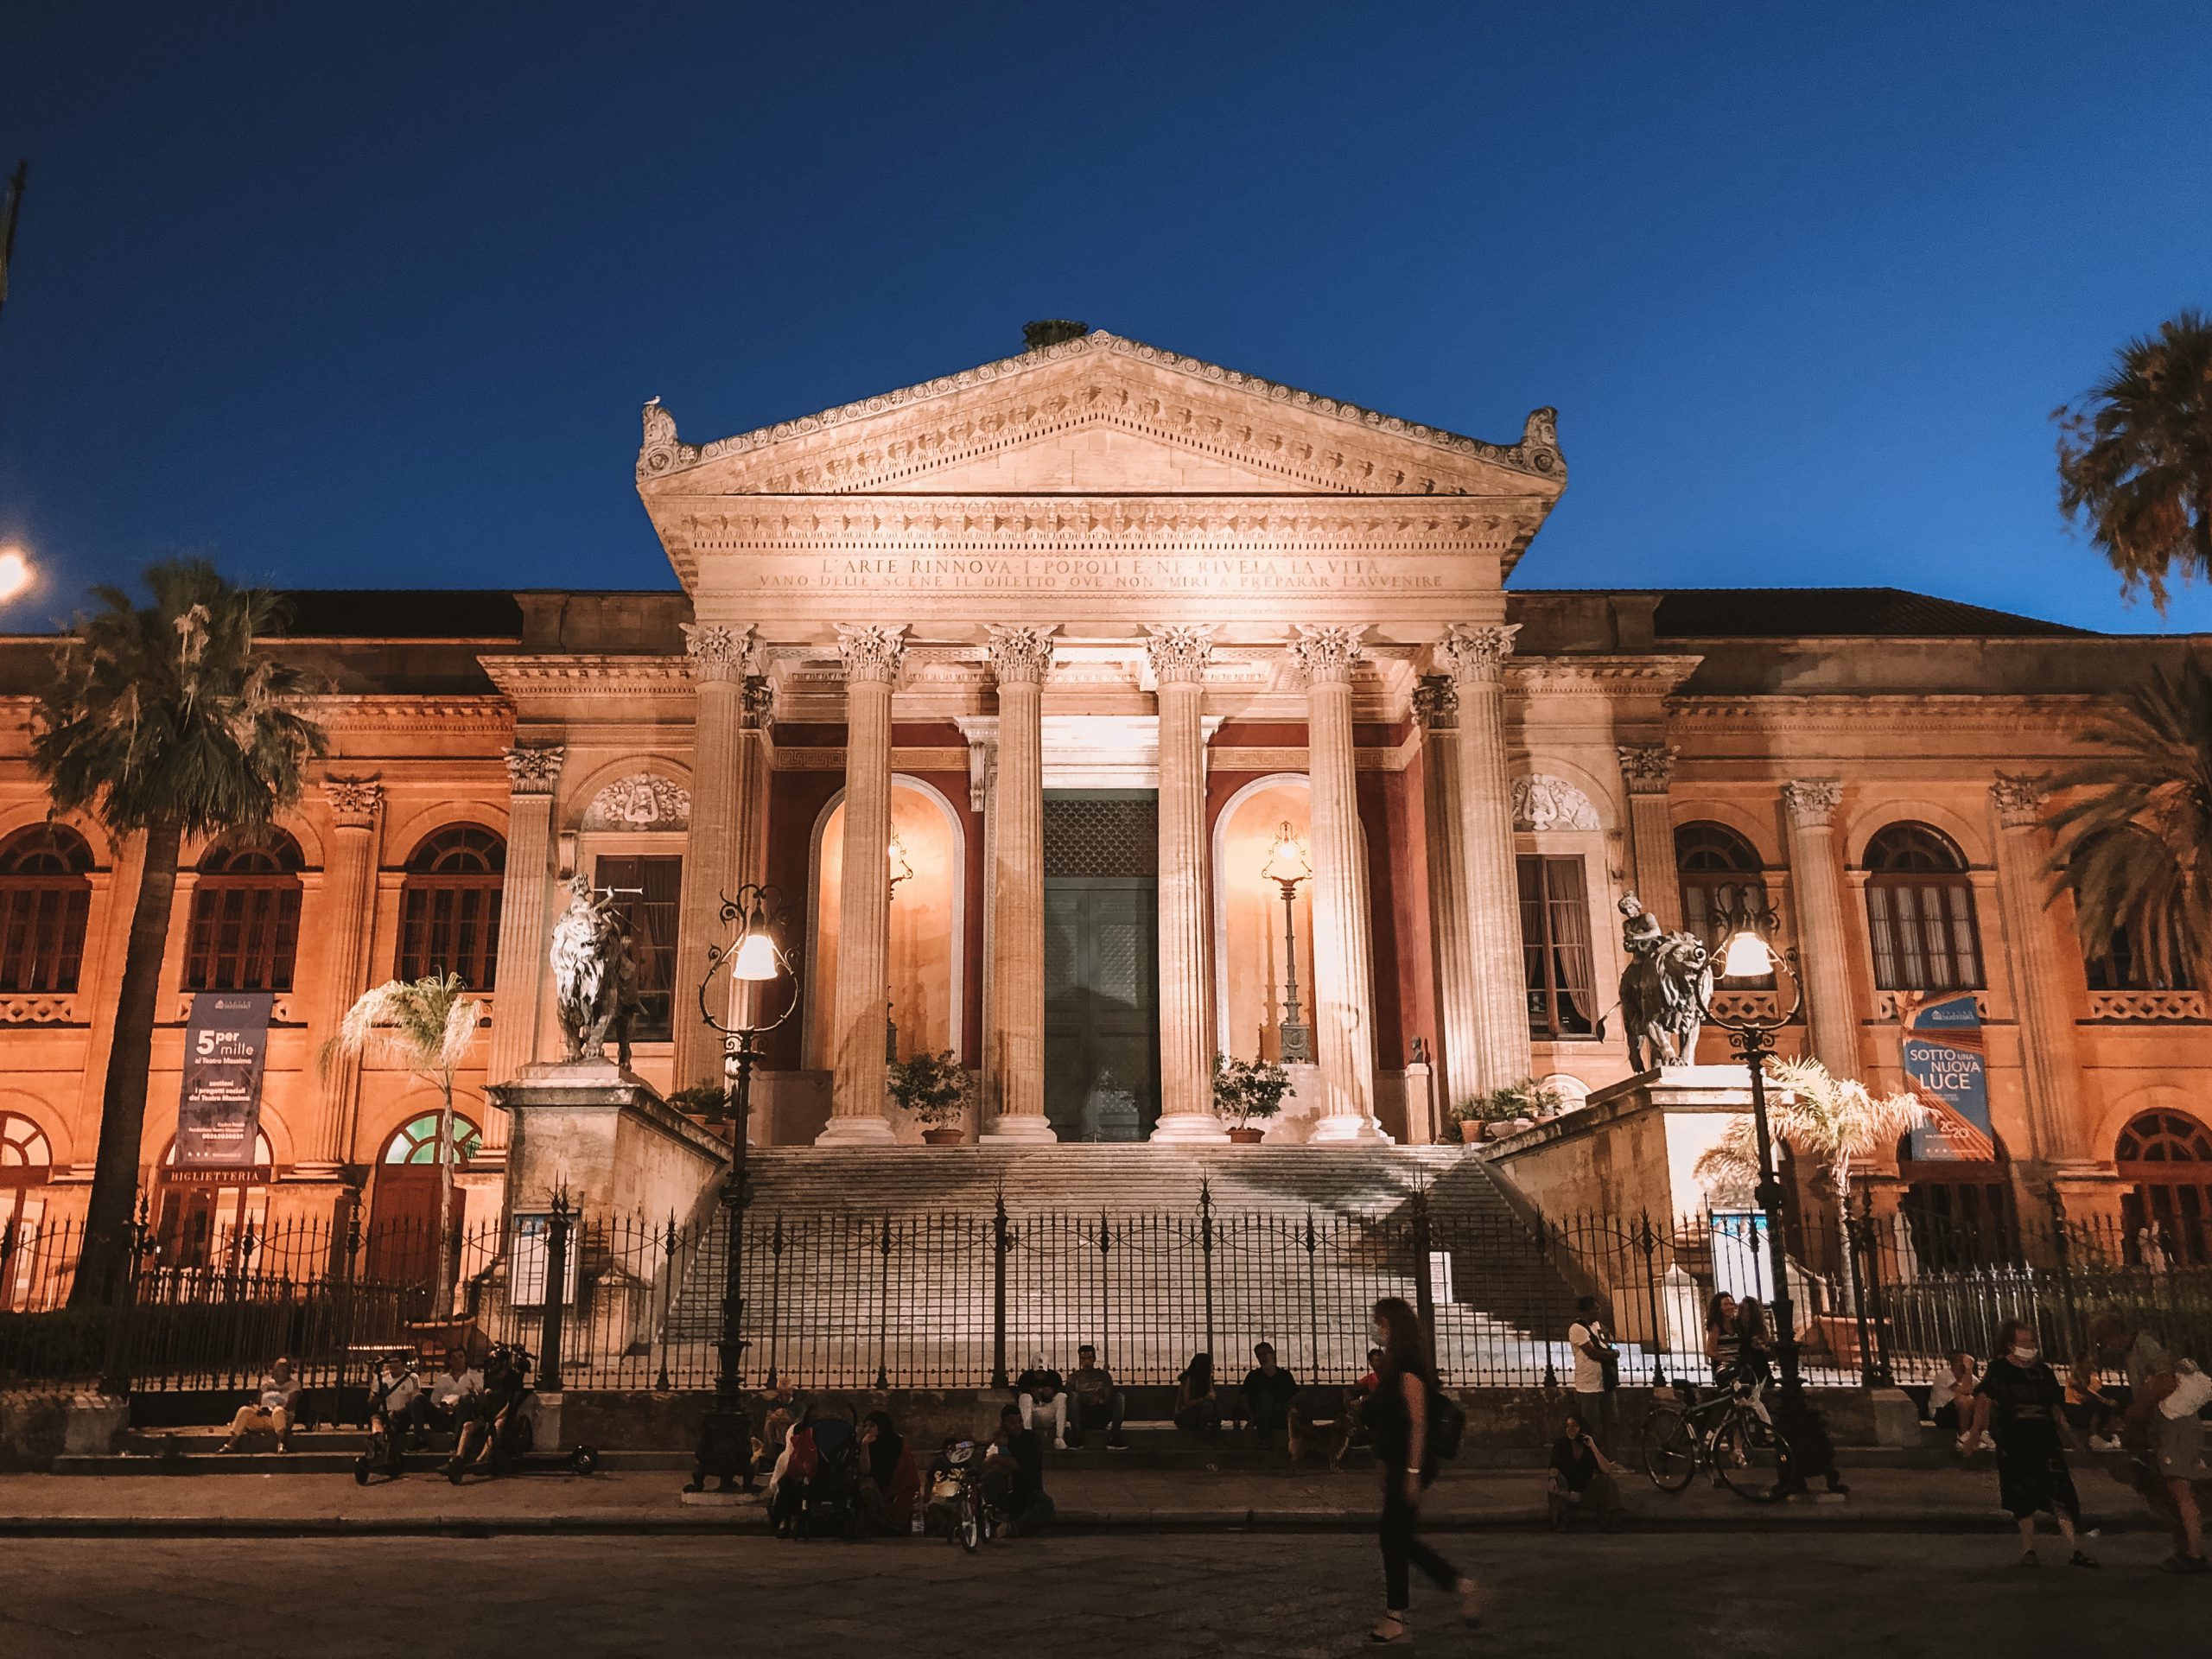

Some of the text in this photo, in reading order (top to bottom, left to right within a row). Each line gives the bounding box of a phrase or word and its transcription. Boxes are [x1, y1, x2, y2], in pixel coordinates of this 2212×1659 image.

[912, 560, 1011, 574] RINNOVA
[1044, 561, 1119, 574] POPOLI
[1135, 561, 1143, 574] E
[1198, 561, 1277, 575] RIVELA
[1292, 561, 1314, 575] LA
[1327, 561, 1381, 574] VITA
[760, 575, 809, 586] VANO
[883, 575, 943, 587] SCENE
[956, 576, 973, 587] IL
[984, 576, 1056, 587] DILETTO
[1070, 576, 1103, 587] OVE
[1116, 576, 1154, 588] NON
[1169, 576, 1209, 587] MIRI
[1240, 576, 1331, 588] PREPARAR
[195, 1030, 239, 1055] 5 per
[220, 1043, 254, 1056] mille
[1910, 1049, 1956, 1061] SOTTO
[1931, 1061, 1981, 1073] NUOVA
[1920, 1073, 1972, 1090] LUCE
[171, 1171, 259, 1181] BIGLIETTERIA
